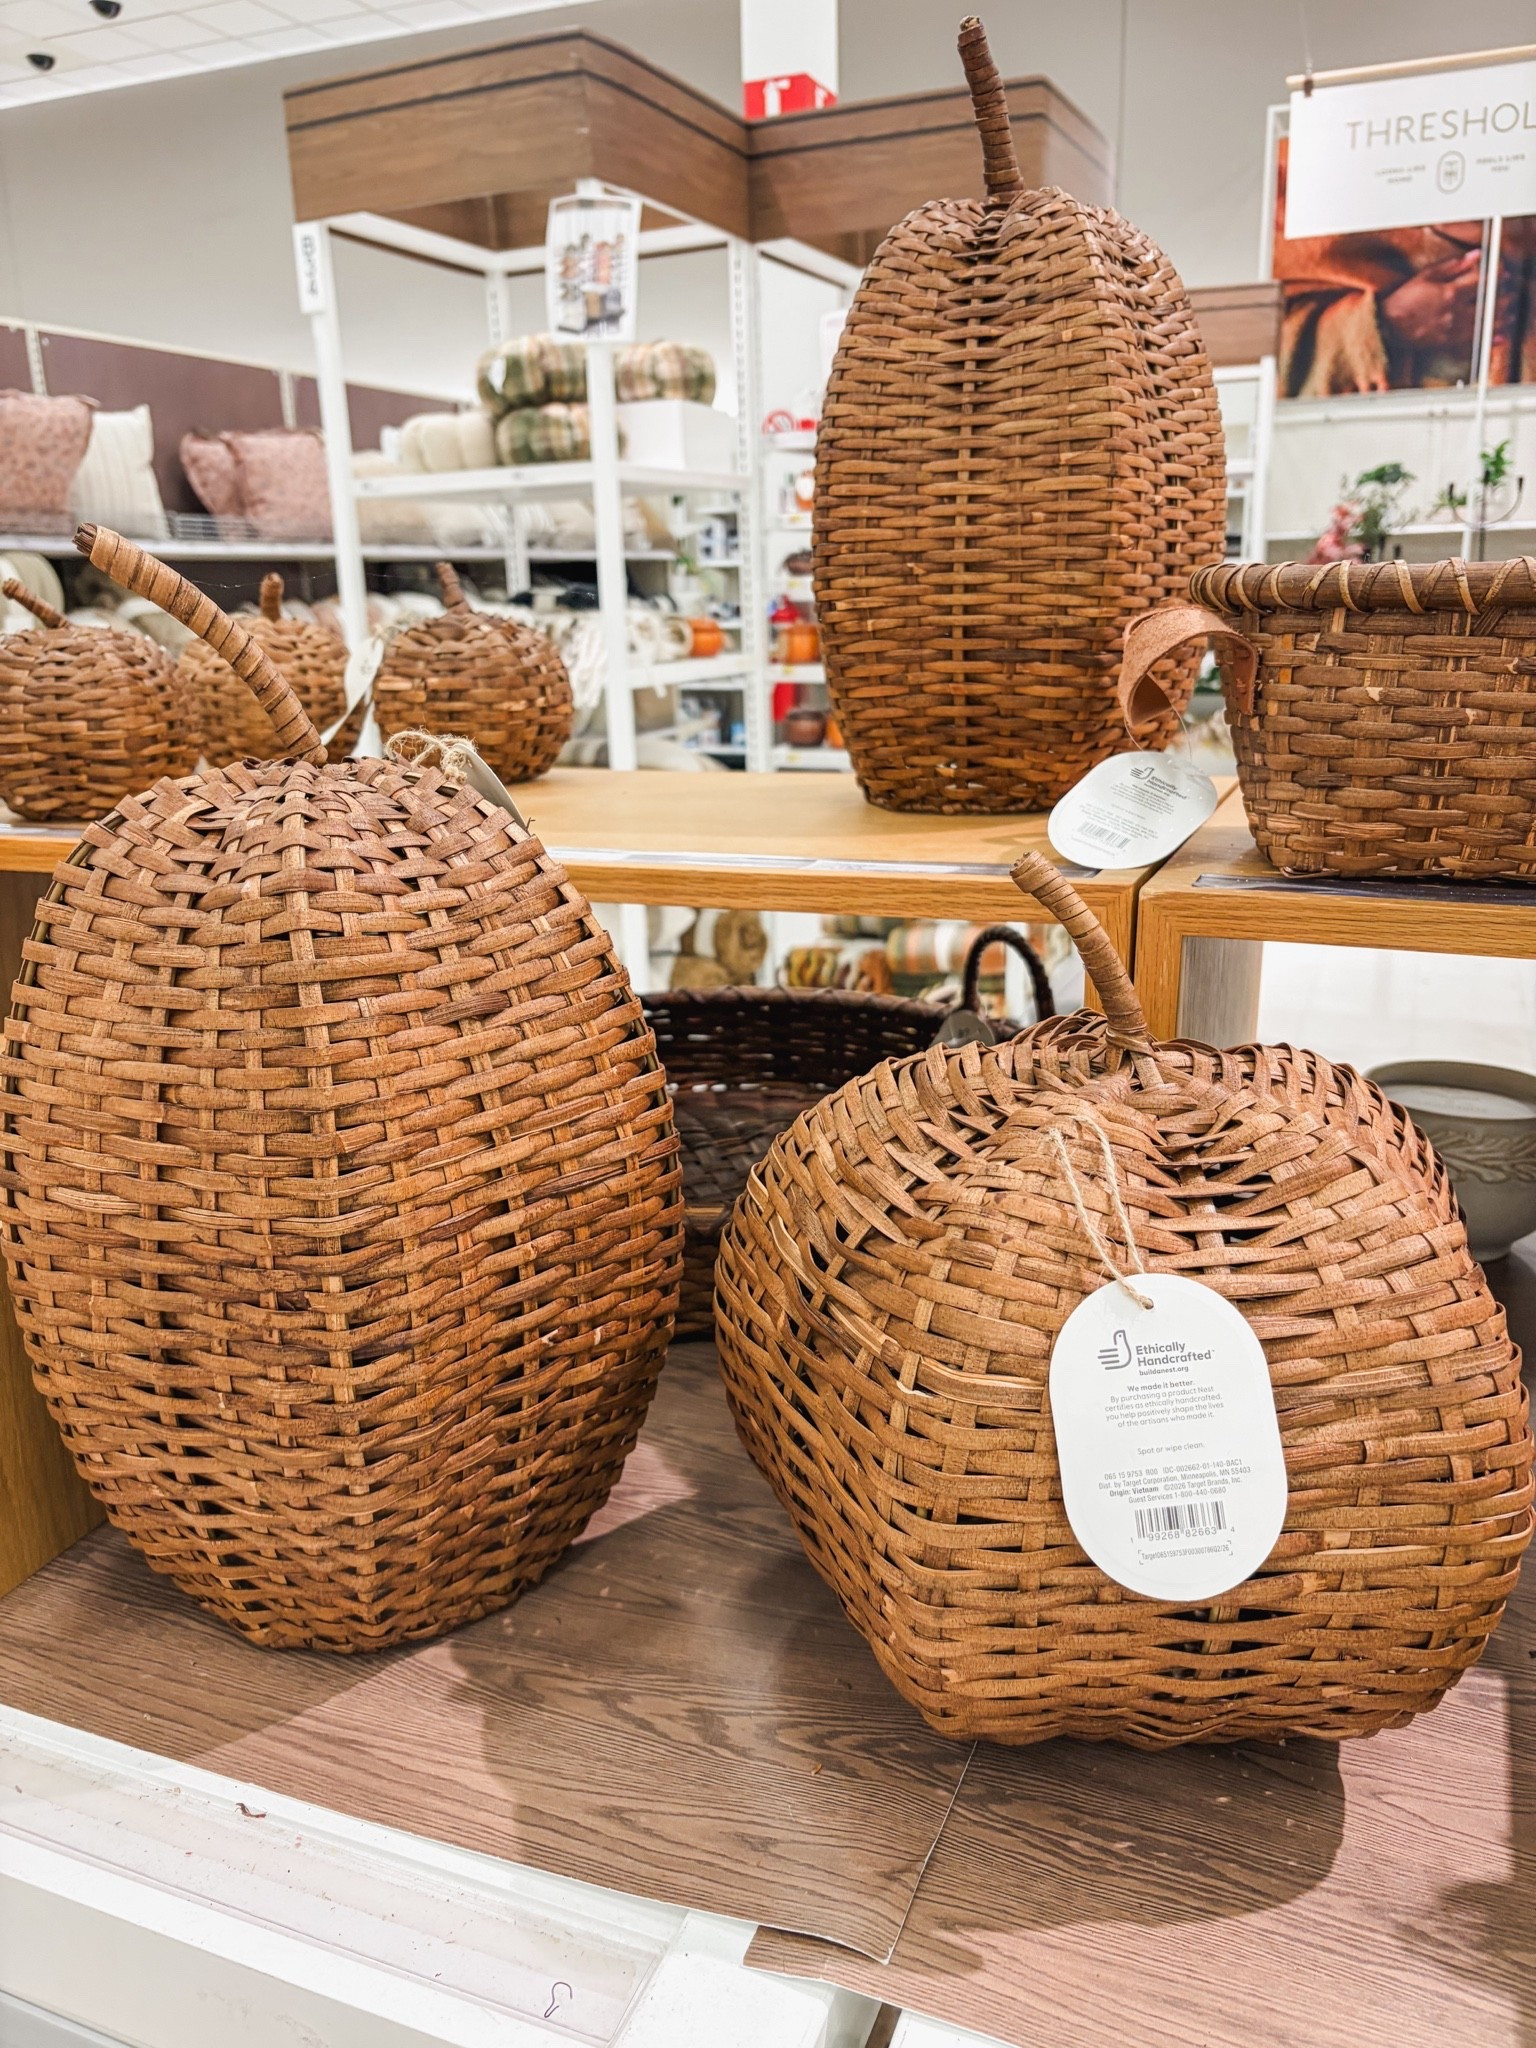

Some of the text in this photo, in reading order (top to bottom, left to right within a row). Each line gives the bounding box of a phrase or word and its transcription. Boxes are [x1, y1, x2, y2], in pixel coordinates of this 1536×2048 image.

[1136, 1342, 1186, 1355] Ethically
[1139, 1366, 1189, 1376] buildanest.org
[1141, 1383, 1162, 1391] made
[1170, 1380, 1196, 1388] better.
[1110, 1396, 1119, 1404] By
[1121, 1392, 1161, 1402] purchasing
[1168, 1388, 1197, 1398] product
[1105, 1404, 1134, 1412] certifies
[1145, 1398, 1174, 1408] ethically
[1106, 1414, 1119, 1422] you
[1120, 1411, 1136, 1419] help
[1138, 1408, 1170, 1418] positively
[1172, 1406, 1194, 1414] shape
[1140, 1417, 1169, 1426] artisans
[1170, 1414, 1185, 1422] who
[1186, 1412, 1207, 1420] made
[1137, 1447, 1154, 1456] Spot
[1165, 1444, 1182, 1452] wipe
[1109, 1489, 1131, 1498] Origin:
[1132, 1486, 1159, 1494] Vietnam
[1187, 1480, 1206, 1489] Target
[1122, 1479, 1142, 1487] Target
[1128, 1496, 1146, 1504] Guest
[1147, 1493, 1173, 1502] Services
[1148, 1531, 1180, 1542] 99268
[1185, 1526, 1217, 1538] 82663
